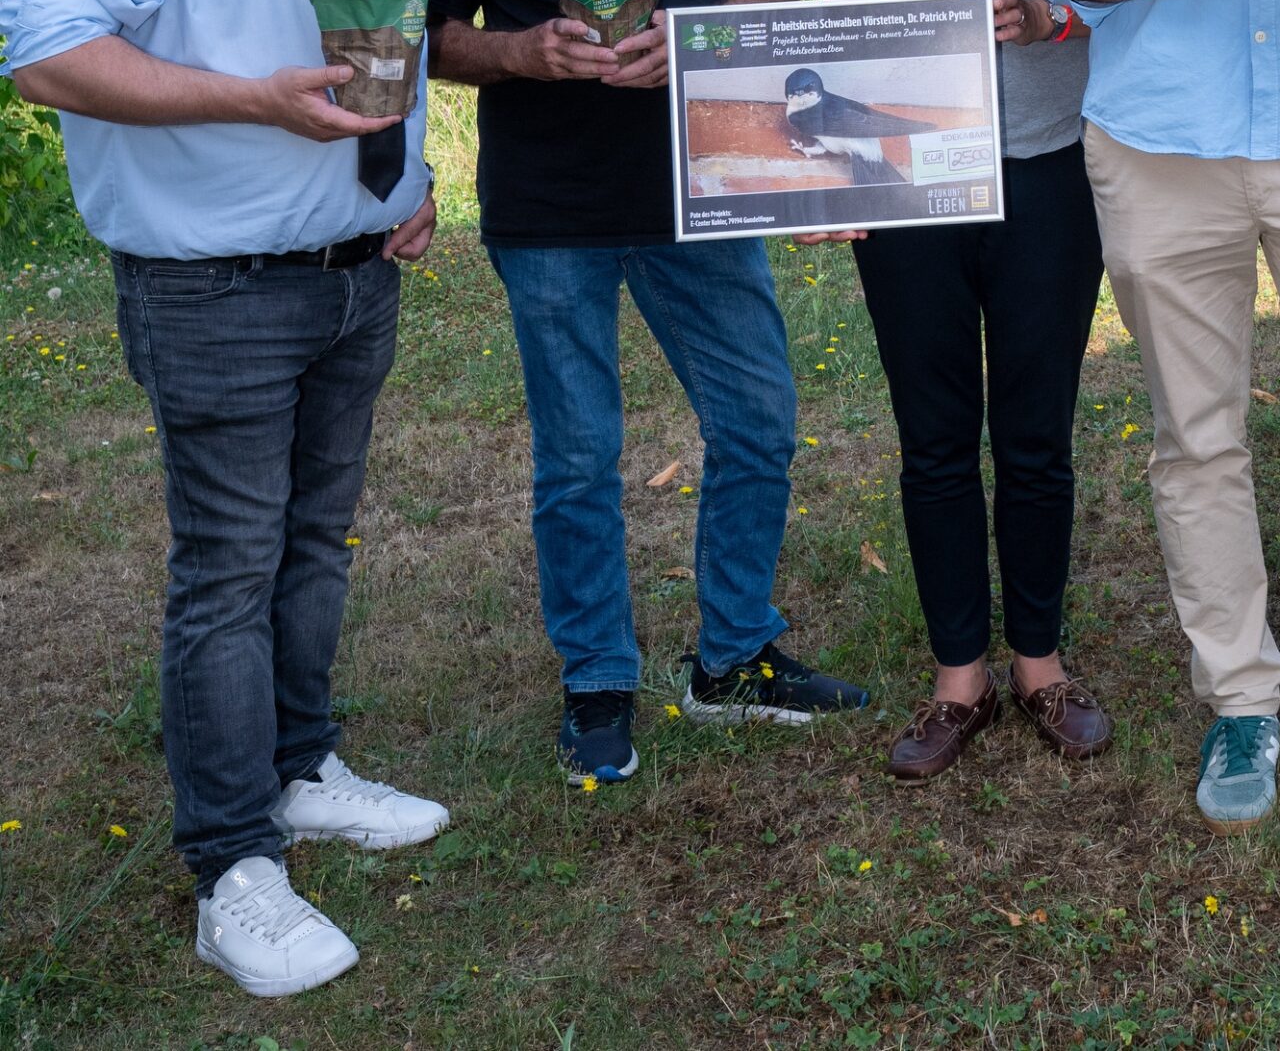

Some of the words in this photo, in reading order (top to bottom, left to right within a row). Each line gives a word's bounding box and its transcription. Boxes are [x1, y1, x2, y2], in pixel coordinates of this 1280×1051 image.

[593, 3, 616, 11] HEIMAT
[772, 19, 818, 32] Arbeitskreis
[820, 16, 861, 29] Schwalben
[863, 14, 906, 26] Vörstetten,
[908, 14, 918, 23] Dr.
[920, 11, 947, 22] Patrick
[949, 9, 972, 22] Pyttel
[772, 36, 798, 46] Projekt
[800, 32, 859, 43] Schwalbenhaus
[866, 31, 878, 39] Ein
[903, 28, 935, 37] Zuhause
[773, 48, 784, 57] für
[786, 46, 844, 55] Mehlschwalben
[952, 148, 991, 167] 2500
[928, 187, 964, 198] #ZUKUNFT
[928, 198, 966, 214] LEBEN
[711, 210, 732, 218] Projekts:
